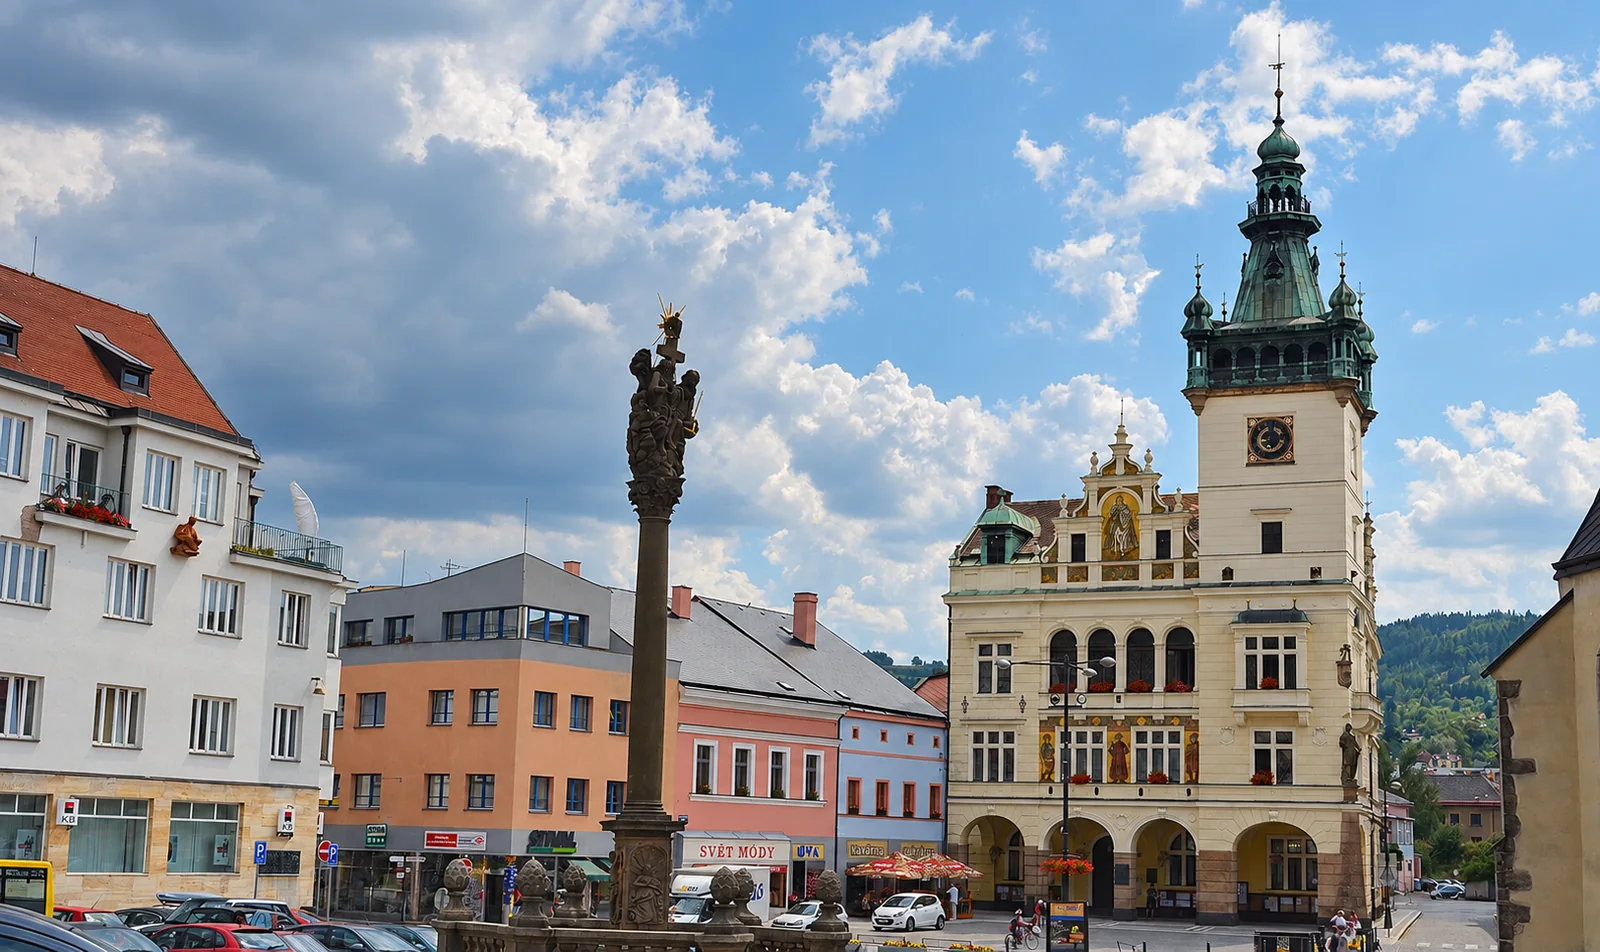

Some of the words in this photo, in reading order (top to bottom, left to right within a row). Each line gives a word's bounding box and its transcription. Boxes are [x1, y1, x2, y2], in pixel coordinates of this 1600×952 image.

[257, 843, 265, 857] P
[699, 843, 733, 858] SVĚT
[738, 844, 775, 859] MÓDY
